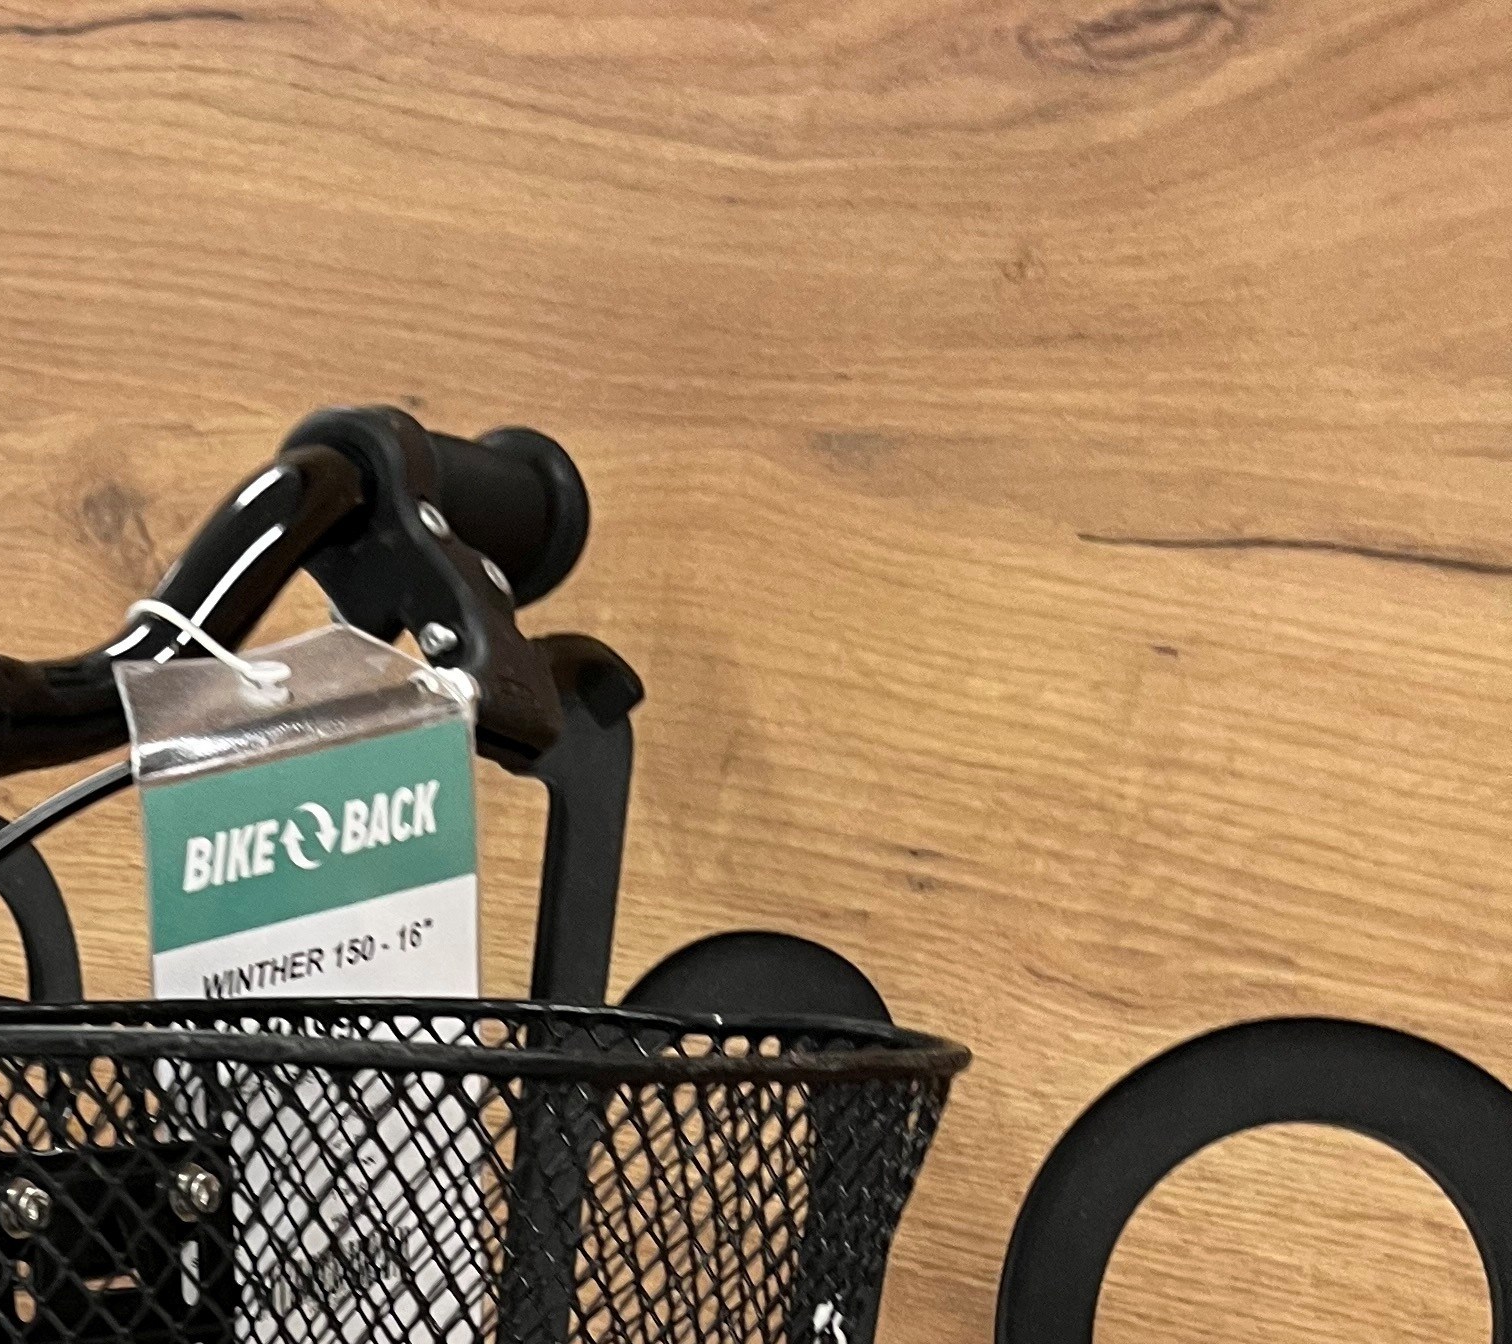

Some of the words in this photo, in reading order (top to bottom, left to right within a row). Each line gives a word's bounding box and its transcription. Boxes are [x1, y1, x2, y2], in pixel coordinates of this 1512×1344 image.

[182, 819, 279, 893] BIKE
[341, 779, 441, 854] BACK
[201, 948, 325, 999] WINTHER
[333, 935, 375, 971] 150
